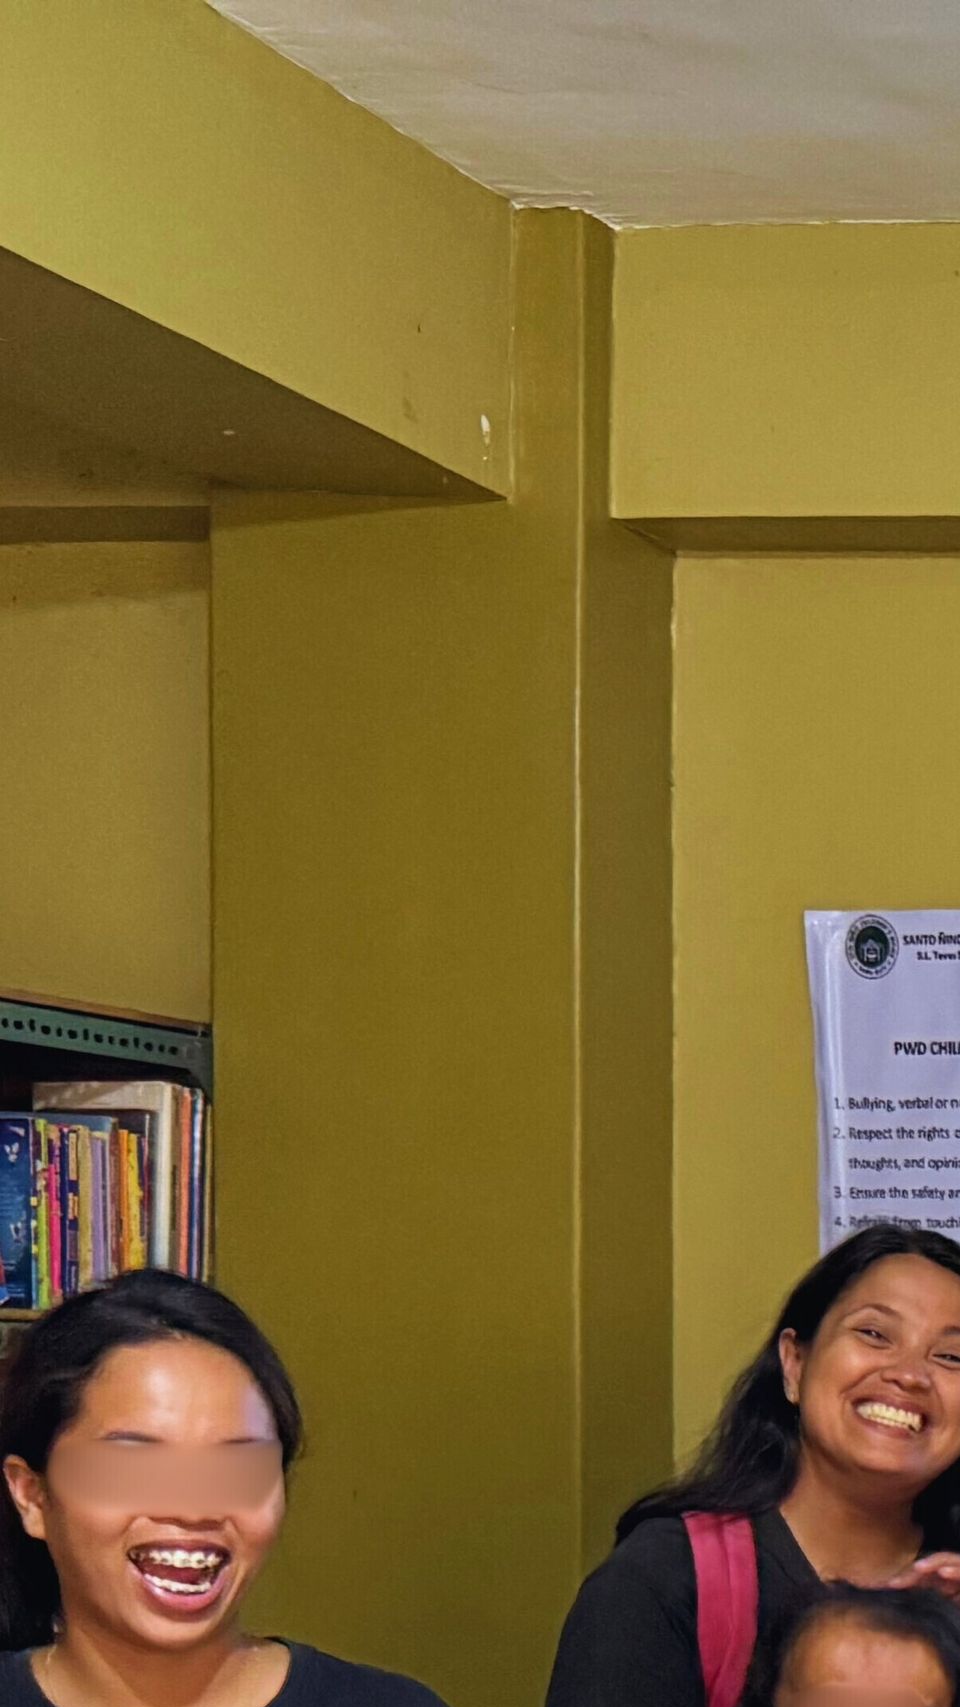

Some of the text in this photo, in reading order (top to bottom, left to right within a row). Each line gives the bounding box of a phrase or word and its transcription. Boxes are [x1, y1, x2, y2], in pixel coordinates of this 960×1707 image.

[903, 933, 937, 945] SANTO
[894, 1040, 927, 1055] PWD
[834, 1097, 845, 1110] 1.
[848, 1096, 896, 1112] Bullying,
[898, 1096, 934, 1110] verbal
[935, 1100, 948, 1110] or
[833, 1126, 846, 1140] 2.
[848, 1126, 893, 1142] Respect
[896, 1126, 916, 1140] the
[918, 1126, 950, 1142] rights
[848, 1156, 901, 1172] thoughts,
[903, 1156, 925, 1170] and
[850, 1186, 886, 1200] Ensure
[888, 1186, 909, 1200] the
[911, 1186, 946, 1201] safety
